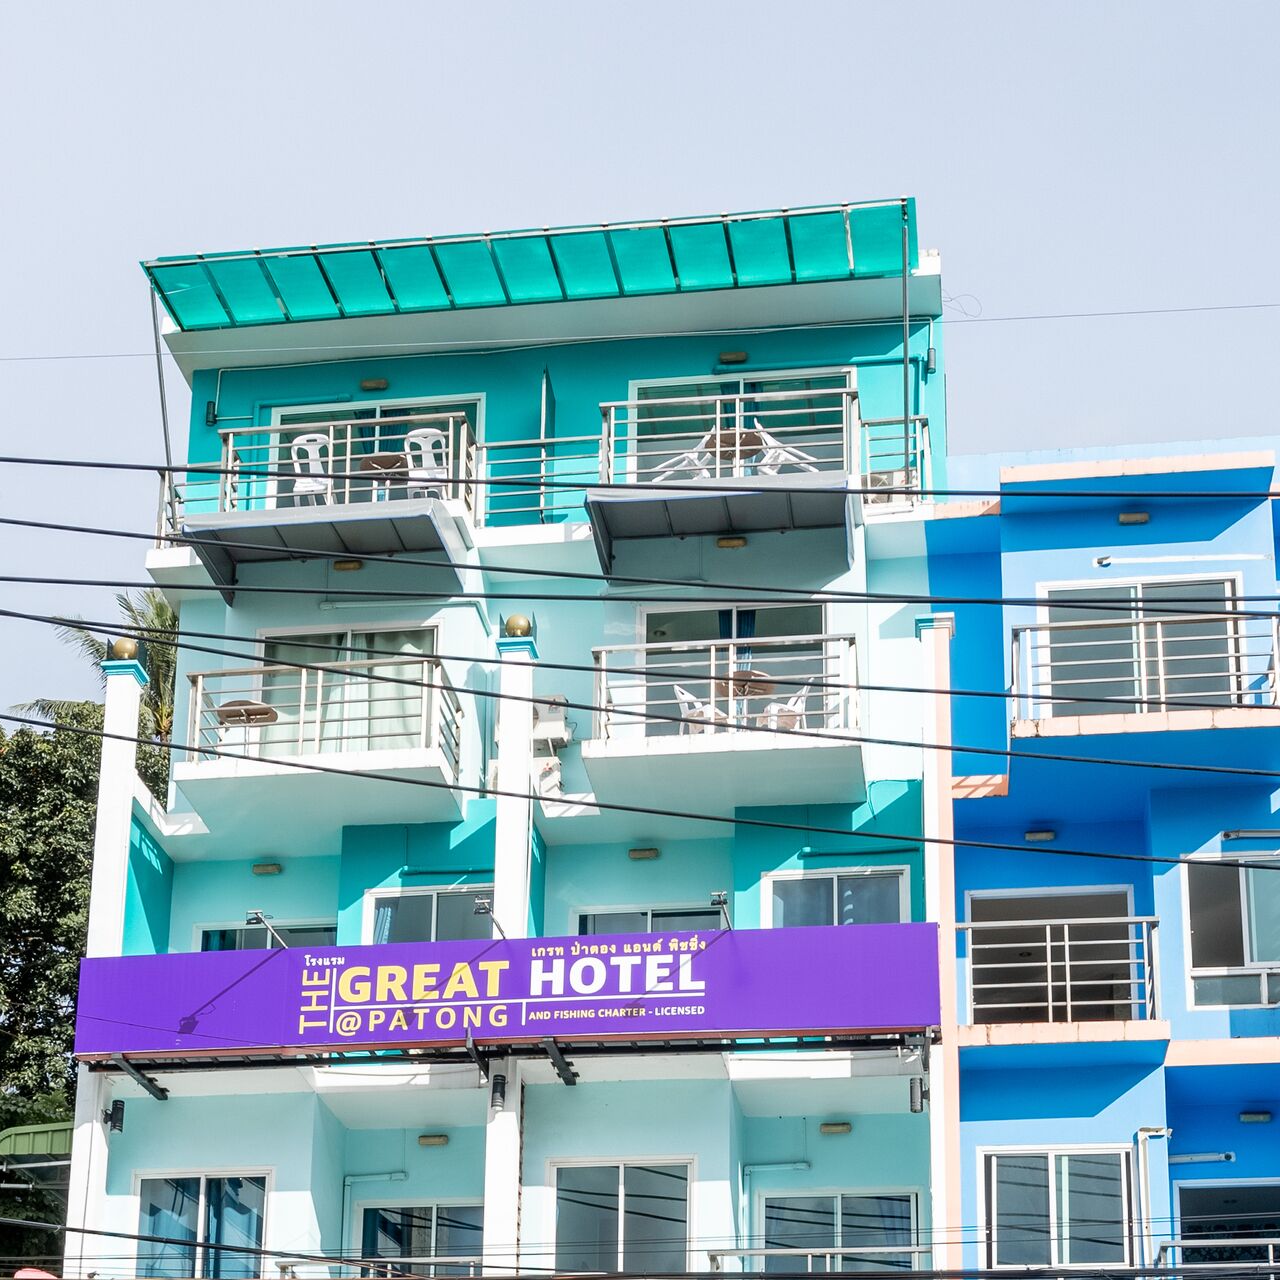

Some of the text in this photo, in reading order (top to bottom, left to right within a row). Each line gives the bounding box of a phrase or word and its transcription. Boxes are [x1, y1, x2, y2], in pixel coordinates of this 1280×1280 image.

[531, 946, 564, 957] เกรท
[571, 941, 616, 955] ป่าตอง
[624, 938, 663, 953] แอนด์
[304, 955, 345, 966] โรงแรม
[338, 953, 705, 1003] GREAT HOTEL
[299, 968, 330, 1034] THE
[528, 1006, 705, 1020] AND FISHING CHARTER LICENSED
[336, 1005, 508, 1036] @PATONG
